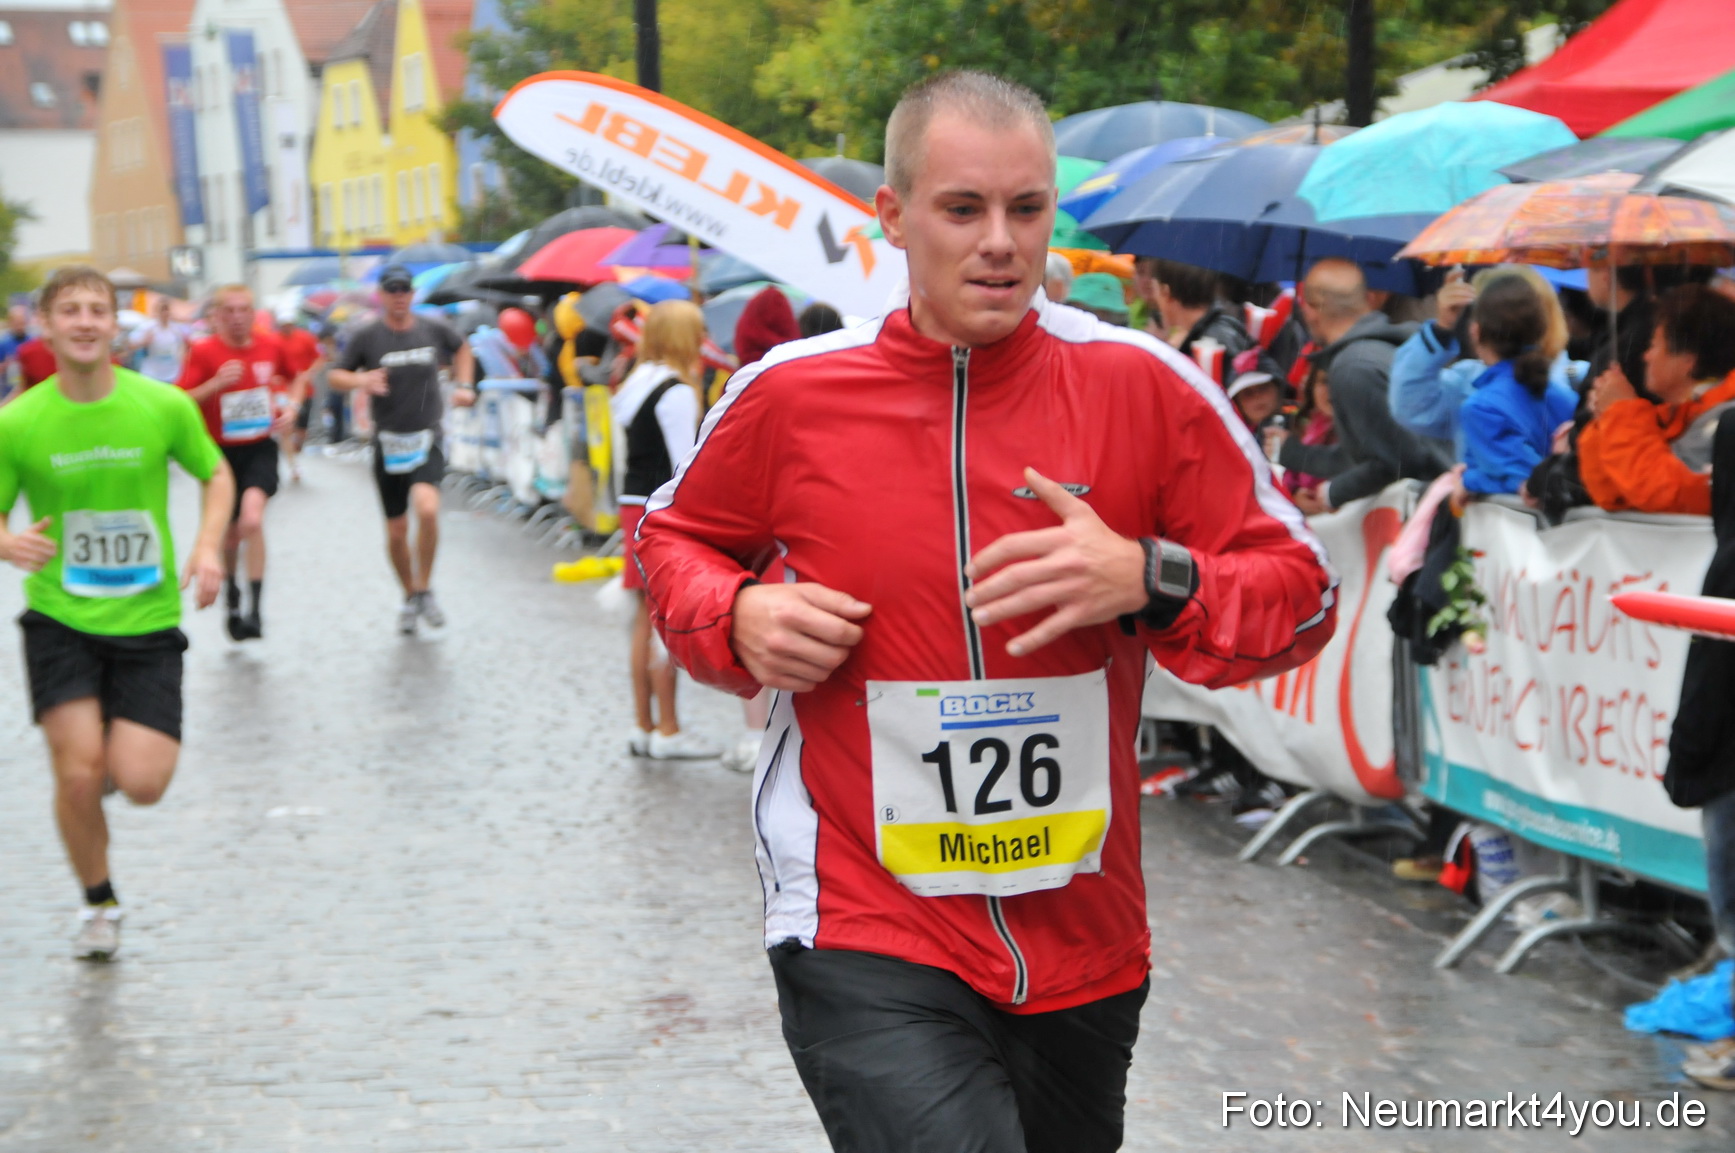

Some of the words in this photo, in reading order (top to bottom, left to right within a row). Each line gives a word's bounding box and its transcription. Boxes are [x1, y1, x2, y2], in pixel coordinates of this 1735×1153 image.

[74, 533, 150, 564] 3107
[940, 692, 1035, 716] BOCK
[922, 733, 1061, 815] 126
[939, 827, 1050, 864] Michael
